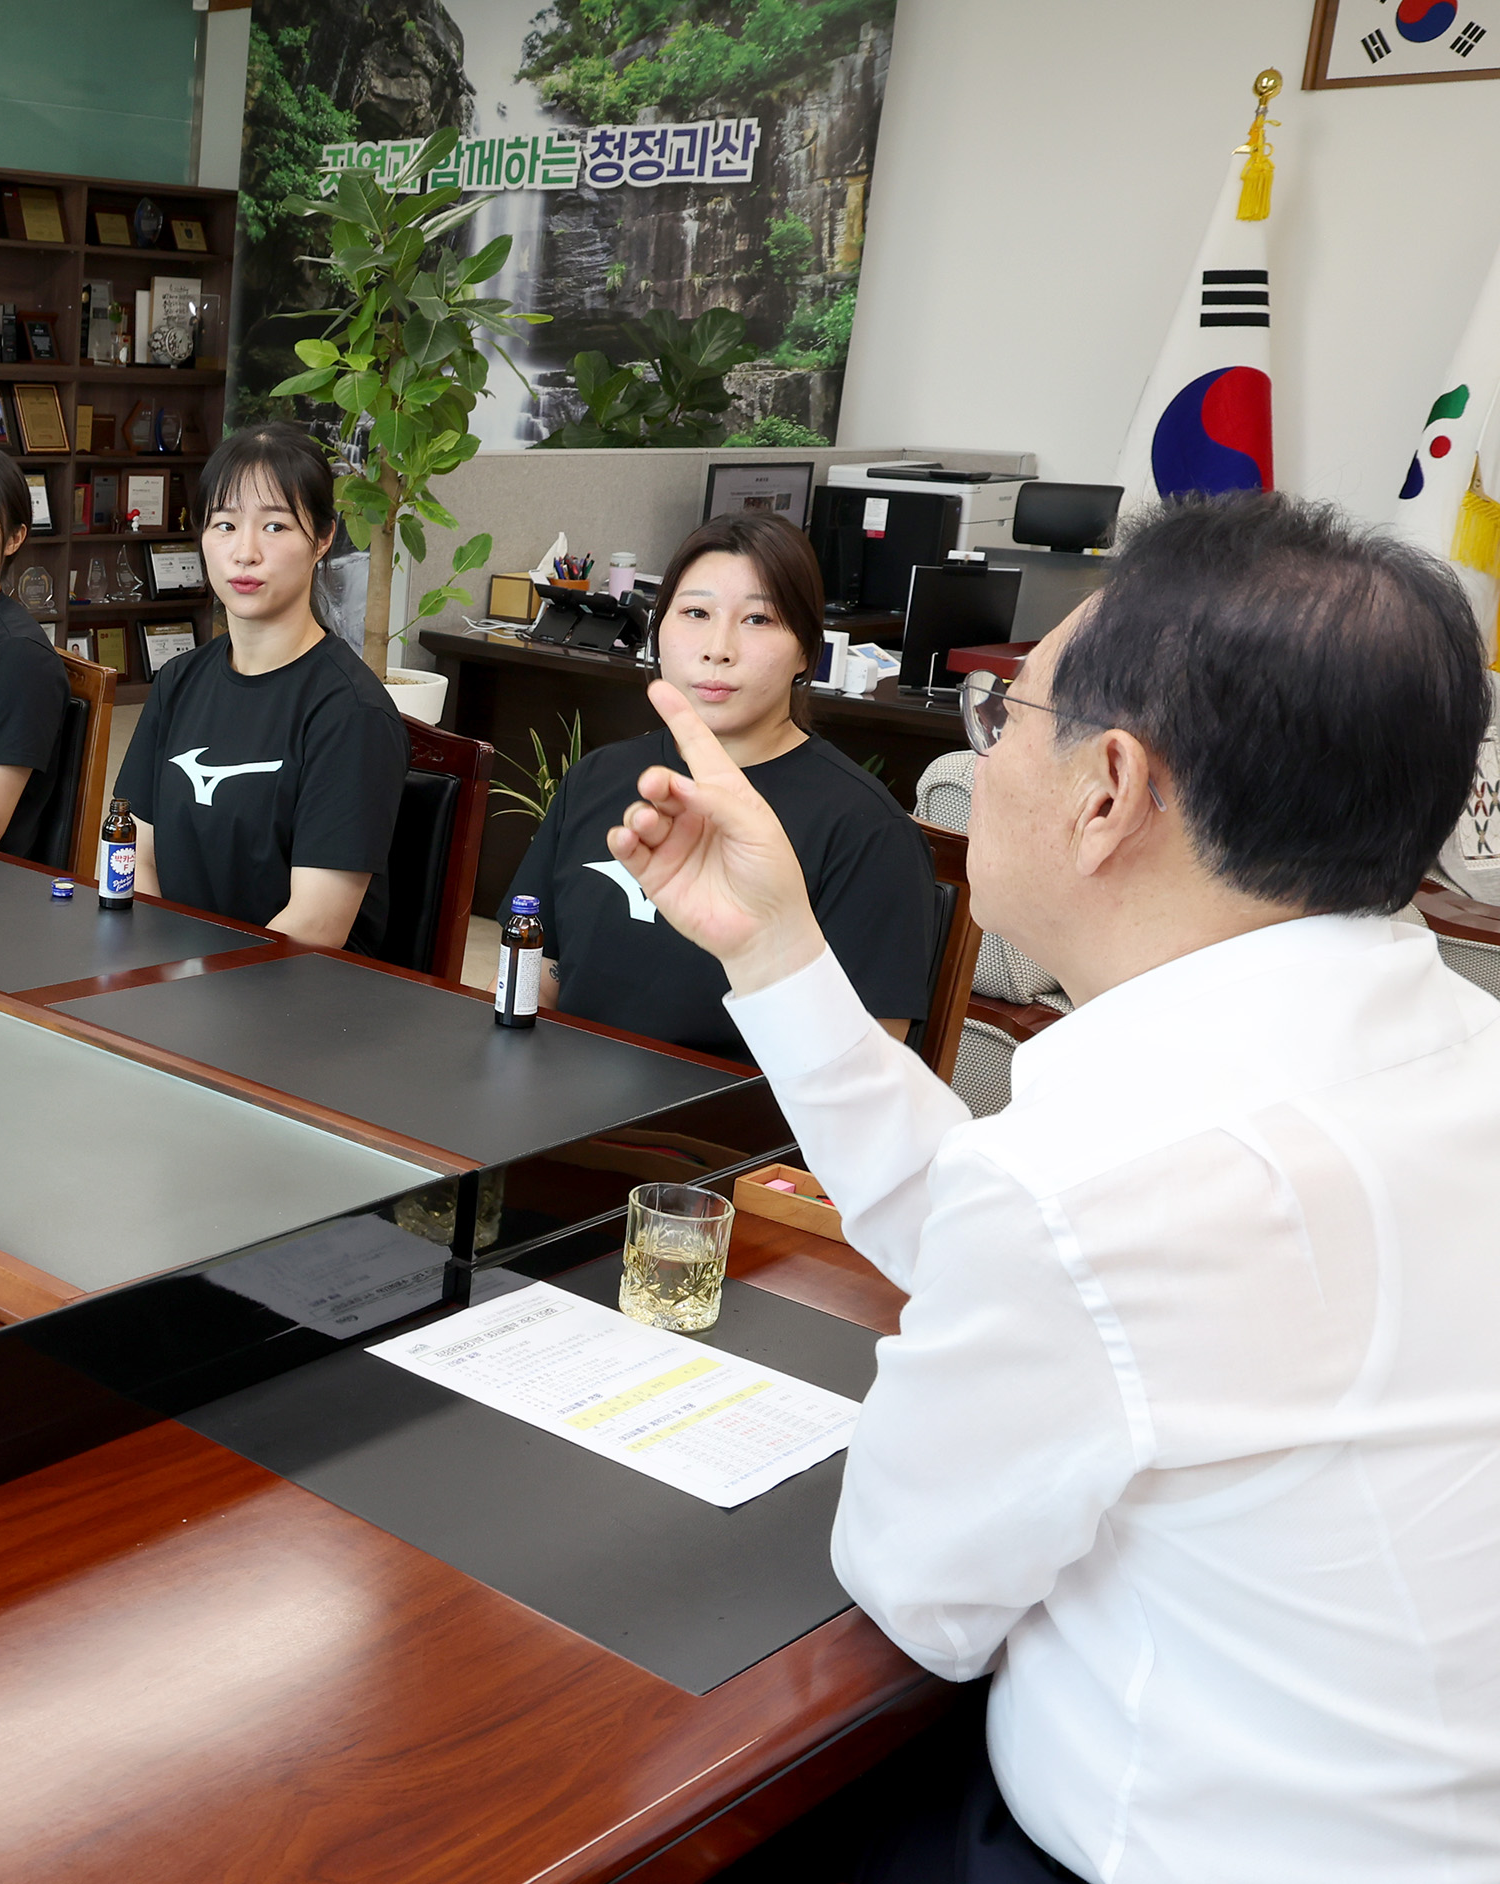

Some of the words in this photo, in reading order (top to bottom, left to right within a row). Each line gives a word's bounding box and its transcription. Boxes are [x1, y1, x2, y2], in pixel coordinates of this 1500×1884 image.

[320, 140, 422, 195] 자연과
[431, 134, 579, 190] 함께하는
[588, 123, 757, 182] 청정괴산
[114, 855, 136, 863] 박카스
